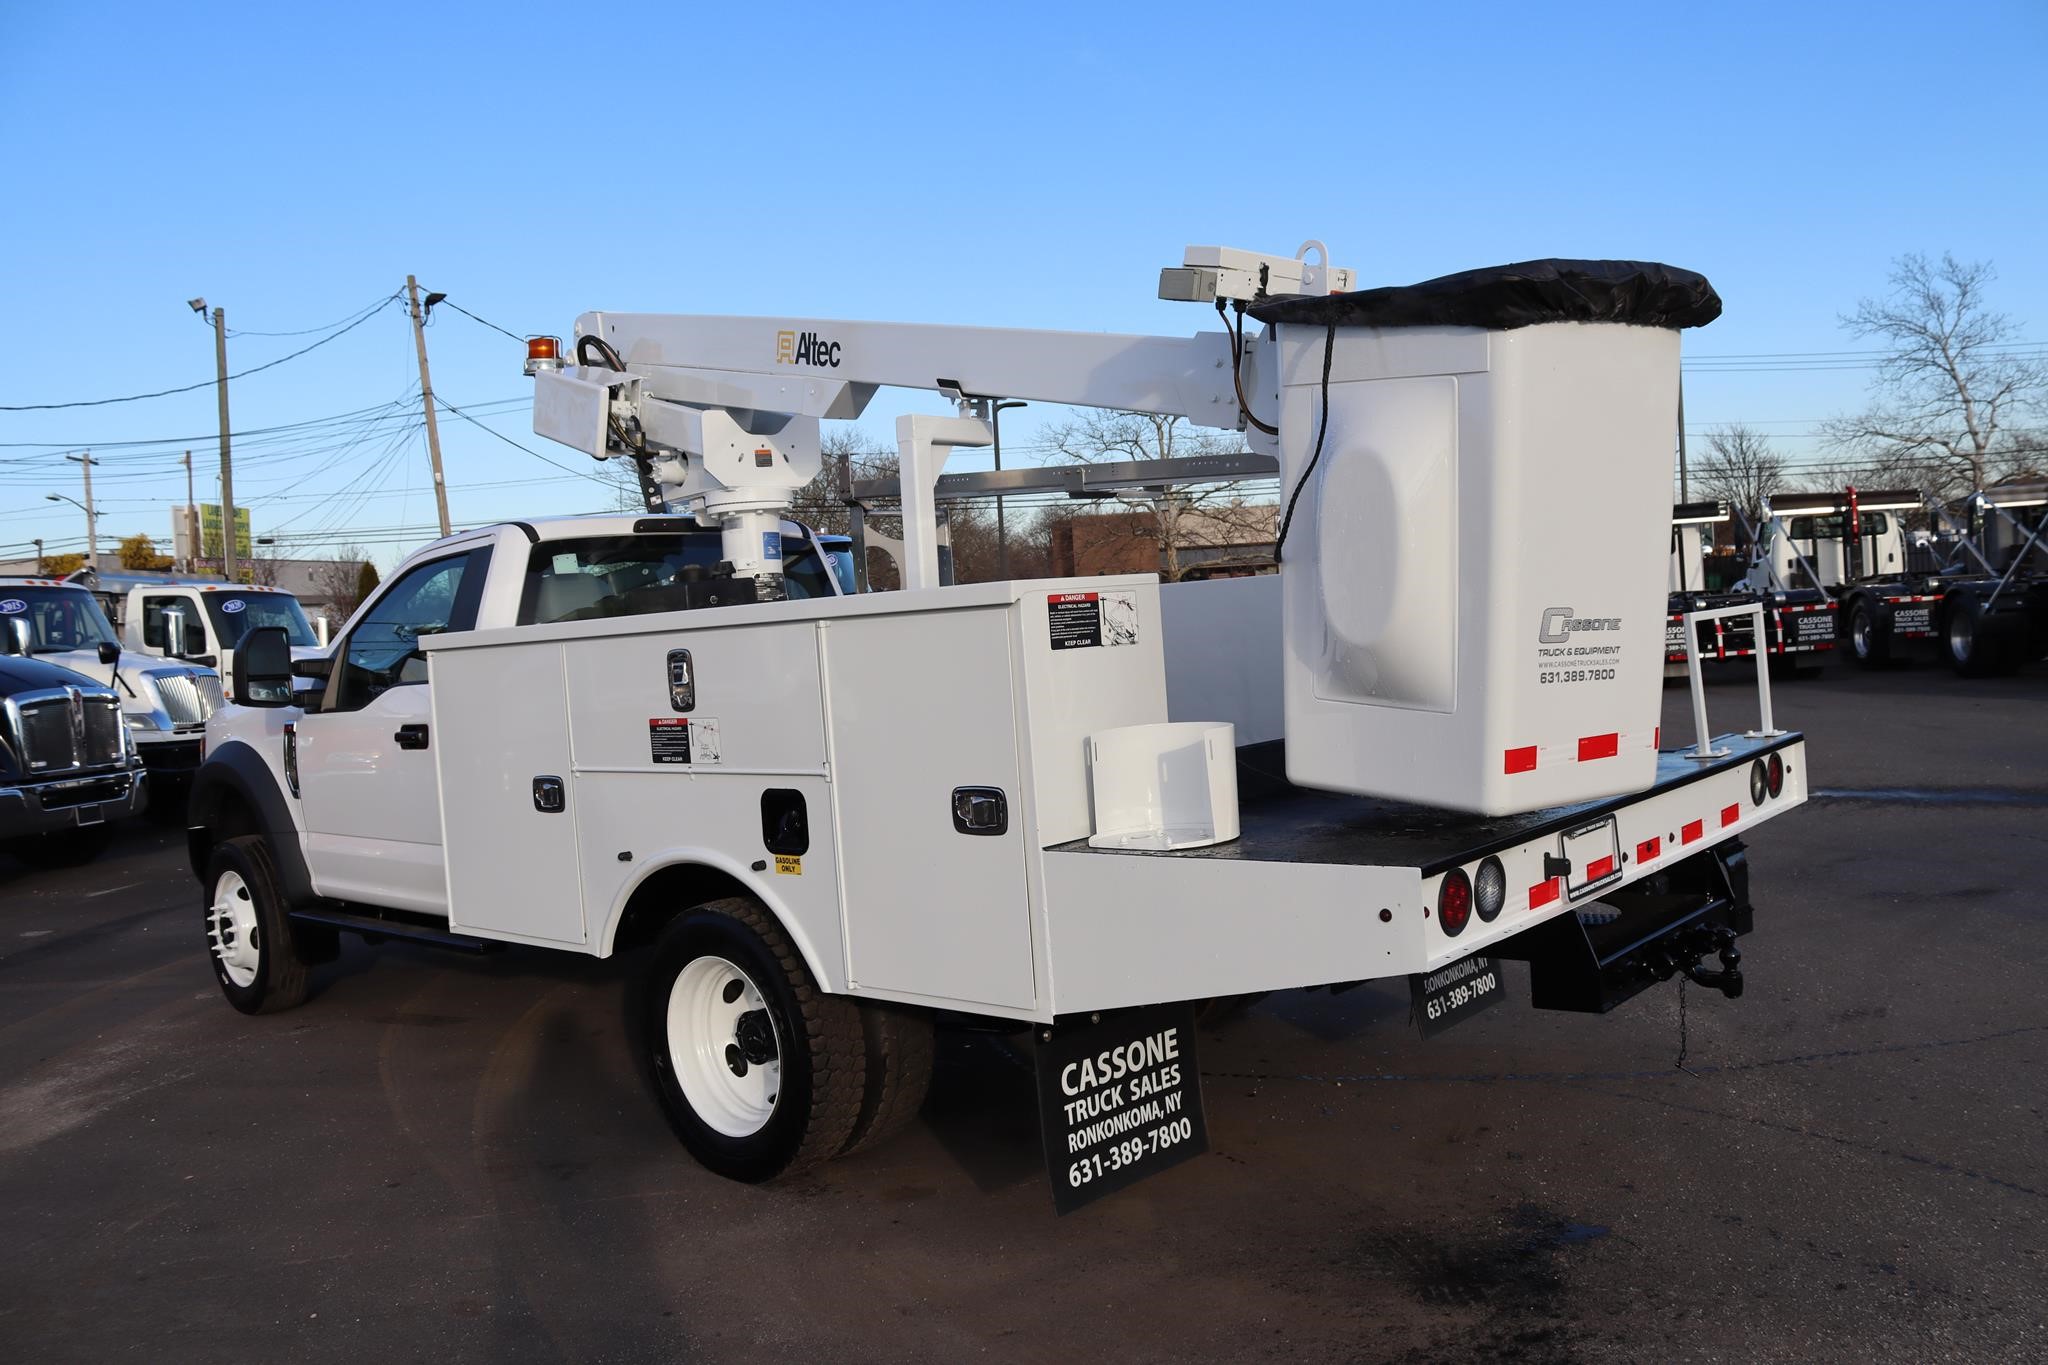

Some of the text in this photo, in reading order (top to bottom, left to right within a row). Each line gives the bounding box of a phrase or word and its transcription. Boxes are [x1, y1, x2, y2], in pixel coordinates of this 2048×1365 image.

[795, 332, 841, 368] Altec
[1798, 615, 1833, 624] CASSONE
[1538, 645, 1622, 657] TRUCK & EQUIPMENT
[1540, 668, 1616, 684] 631.389.7800
[775, 856, 801, 865] GASOLINE
[1427, 972, 1496, 1019] 631-389-7800
[1060, 1027, 1180, 1096] CASSONE
[1063, 1063, 1182, 1126] TRUCK SALES
[1067, 1090, 1183, 1154] RONKONKOMA, NY
[1069, 1117, 1192, 1188] 631-389-7800
